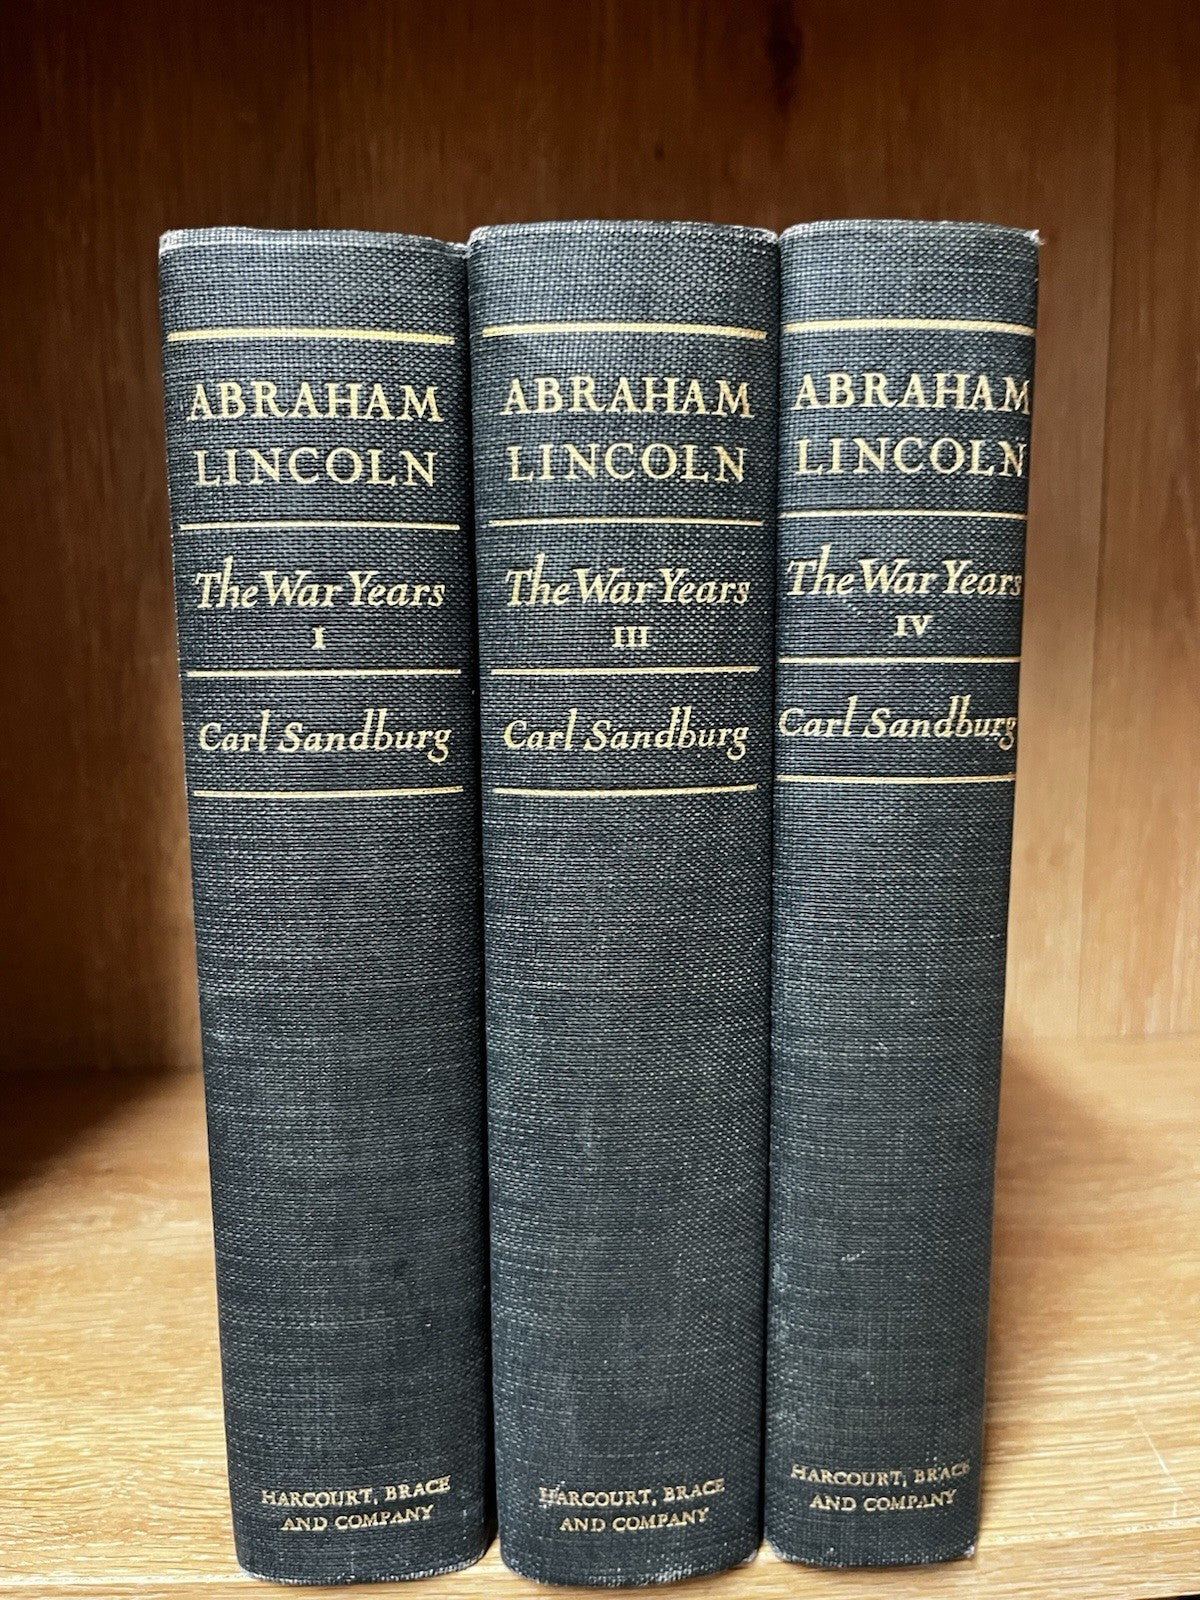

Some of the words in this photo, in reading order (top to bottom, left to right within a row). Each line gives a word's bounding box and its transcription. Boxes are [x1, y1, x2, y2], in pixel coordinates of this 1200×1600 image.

[188, 380, 444, 422] ABRAHAM
[500, 376, 755, 419] ABRAHAM
[794, 372, 1031, 415] ABRAHAM
[194, 447, 438, 487] LINCOLN
[506, 442, 748, 483] LINCOLN
[794, 437, 1027, 477] LINCOLN
[195, 555, 258, 609] The
[258, 569, 344, 609] War
[346, 570, 445, 608] Years
[504, 553, 570, 607] The
[571, 568, 653, 606] War
[653, 568, 750, 605] Years
[786, 544, 857, 597] The
[858, 557, 939, 597] War
[941, 559, 1023, 596] Years
[311, 626, 326, 649] I
[611, 625, 652, 648] III
[894, 615, 933, 637] IV
[199, 709, 269, 753] Carl
[277, 709, 452, 763] Sandburg
[504, 707, 577, 751] Carl
[583, 706, 750, 760] Sandburg
[778, 695, 858, 738] Carl
[862, 695, 1018, 751] Sandburg
[261, 1488, 378, 1508] HARCOURT,
[384, 1475, 451, 1501] BRACE
[538, 1486, 657, 1507] HARCOURT,
[663, 1478, 726, 1501] BRACE
[790, 1463, 908, 1488] HARCOURT,
[280, 1517, 328, 1531] AND
[334, 1504, 434, 1530] COMPANY
[559, 1517, 606, 1532] AND
[612, 1507, 710, 1532] COMPANY
[809, 1494, 857, 1511] AND
[863, 1488, 957, 1512] COMPANY
